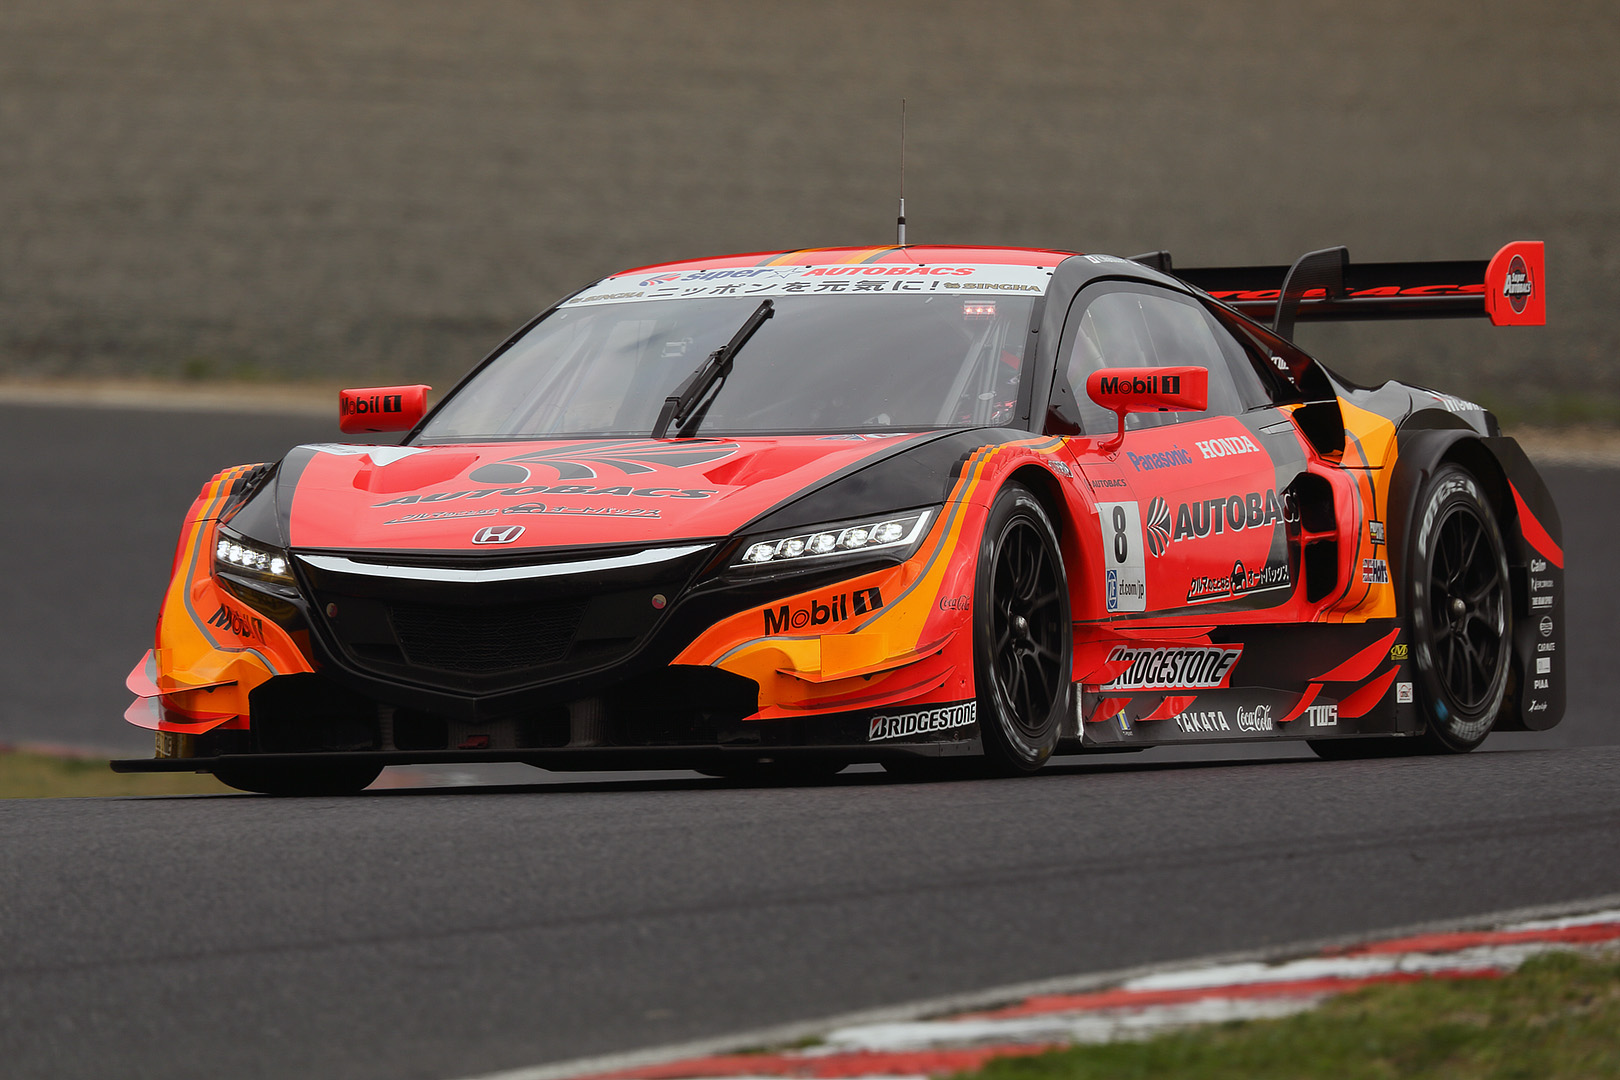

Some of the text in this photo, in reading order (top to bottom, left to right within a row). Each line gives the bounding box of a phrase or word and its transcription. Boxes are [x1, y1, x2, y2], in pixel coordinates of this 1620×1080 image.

[801, 267, 976, 277] AUTOBACS
[961, 282, 1042, 292] SINGHA
[1101, 376, 1177, 394] Mobil 1
[341, 396, 380, 416] Mobil
[1126, 444, 1193, 472] Panasonic
[1195, 435, 1260, 460] HONDA
[1091, 479, 1127, 488] AUTOBACS
[370, 485, 719, 508] AUTOBACS
[1112, 505, 1128, 564] 8
[763, 588, 879, 636] Mobil 1
[1534, 679, 1549, 689] PIAA
[869, 701, 976, 741] BRIDGESTONE
[1174, 711, 1230, 733] TAKATA
[1236, 705, 1273, 732] Coca-Cola
[1304, 704, 1338, 726] TWS
